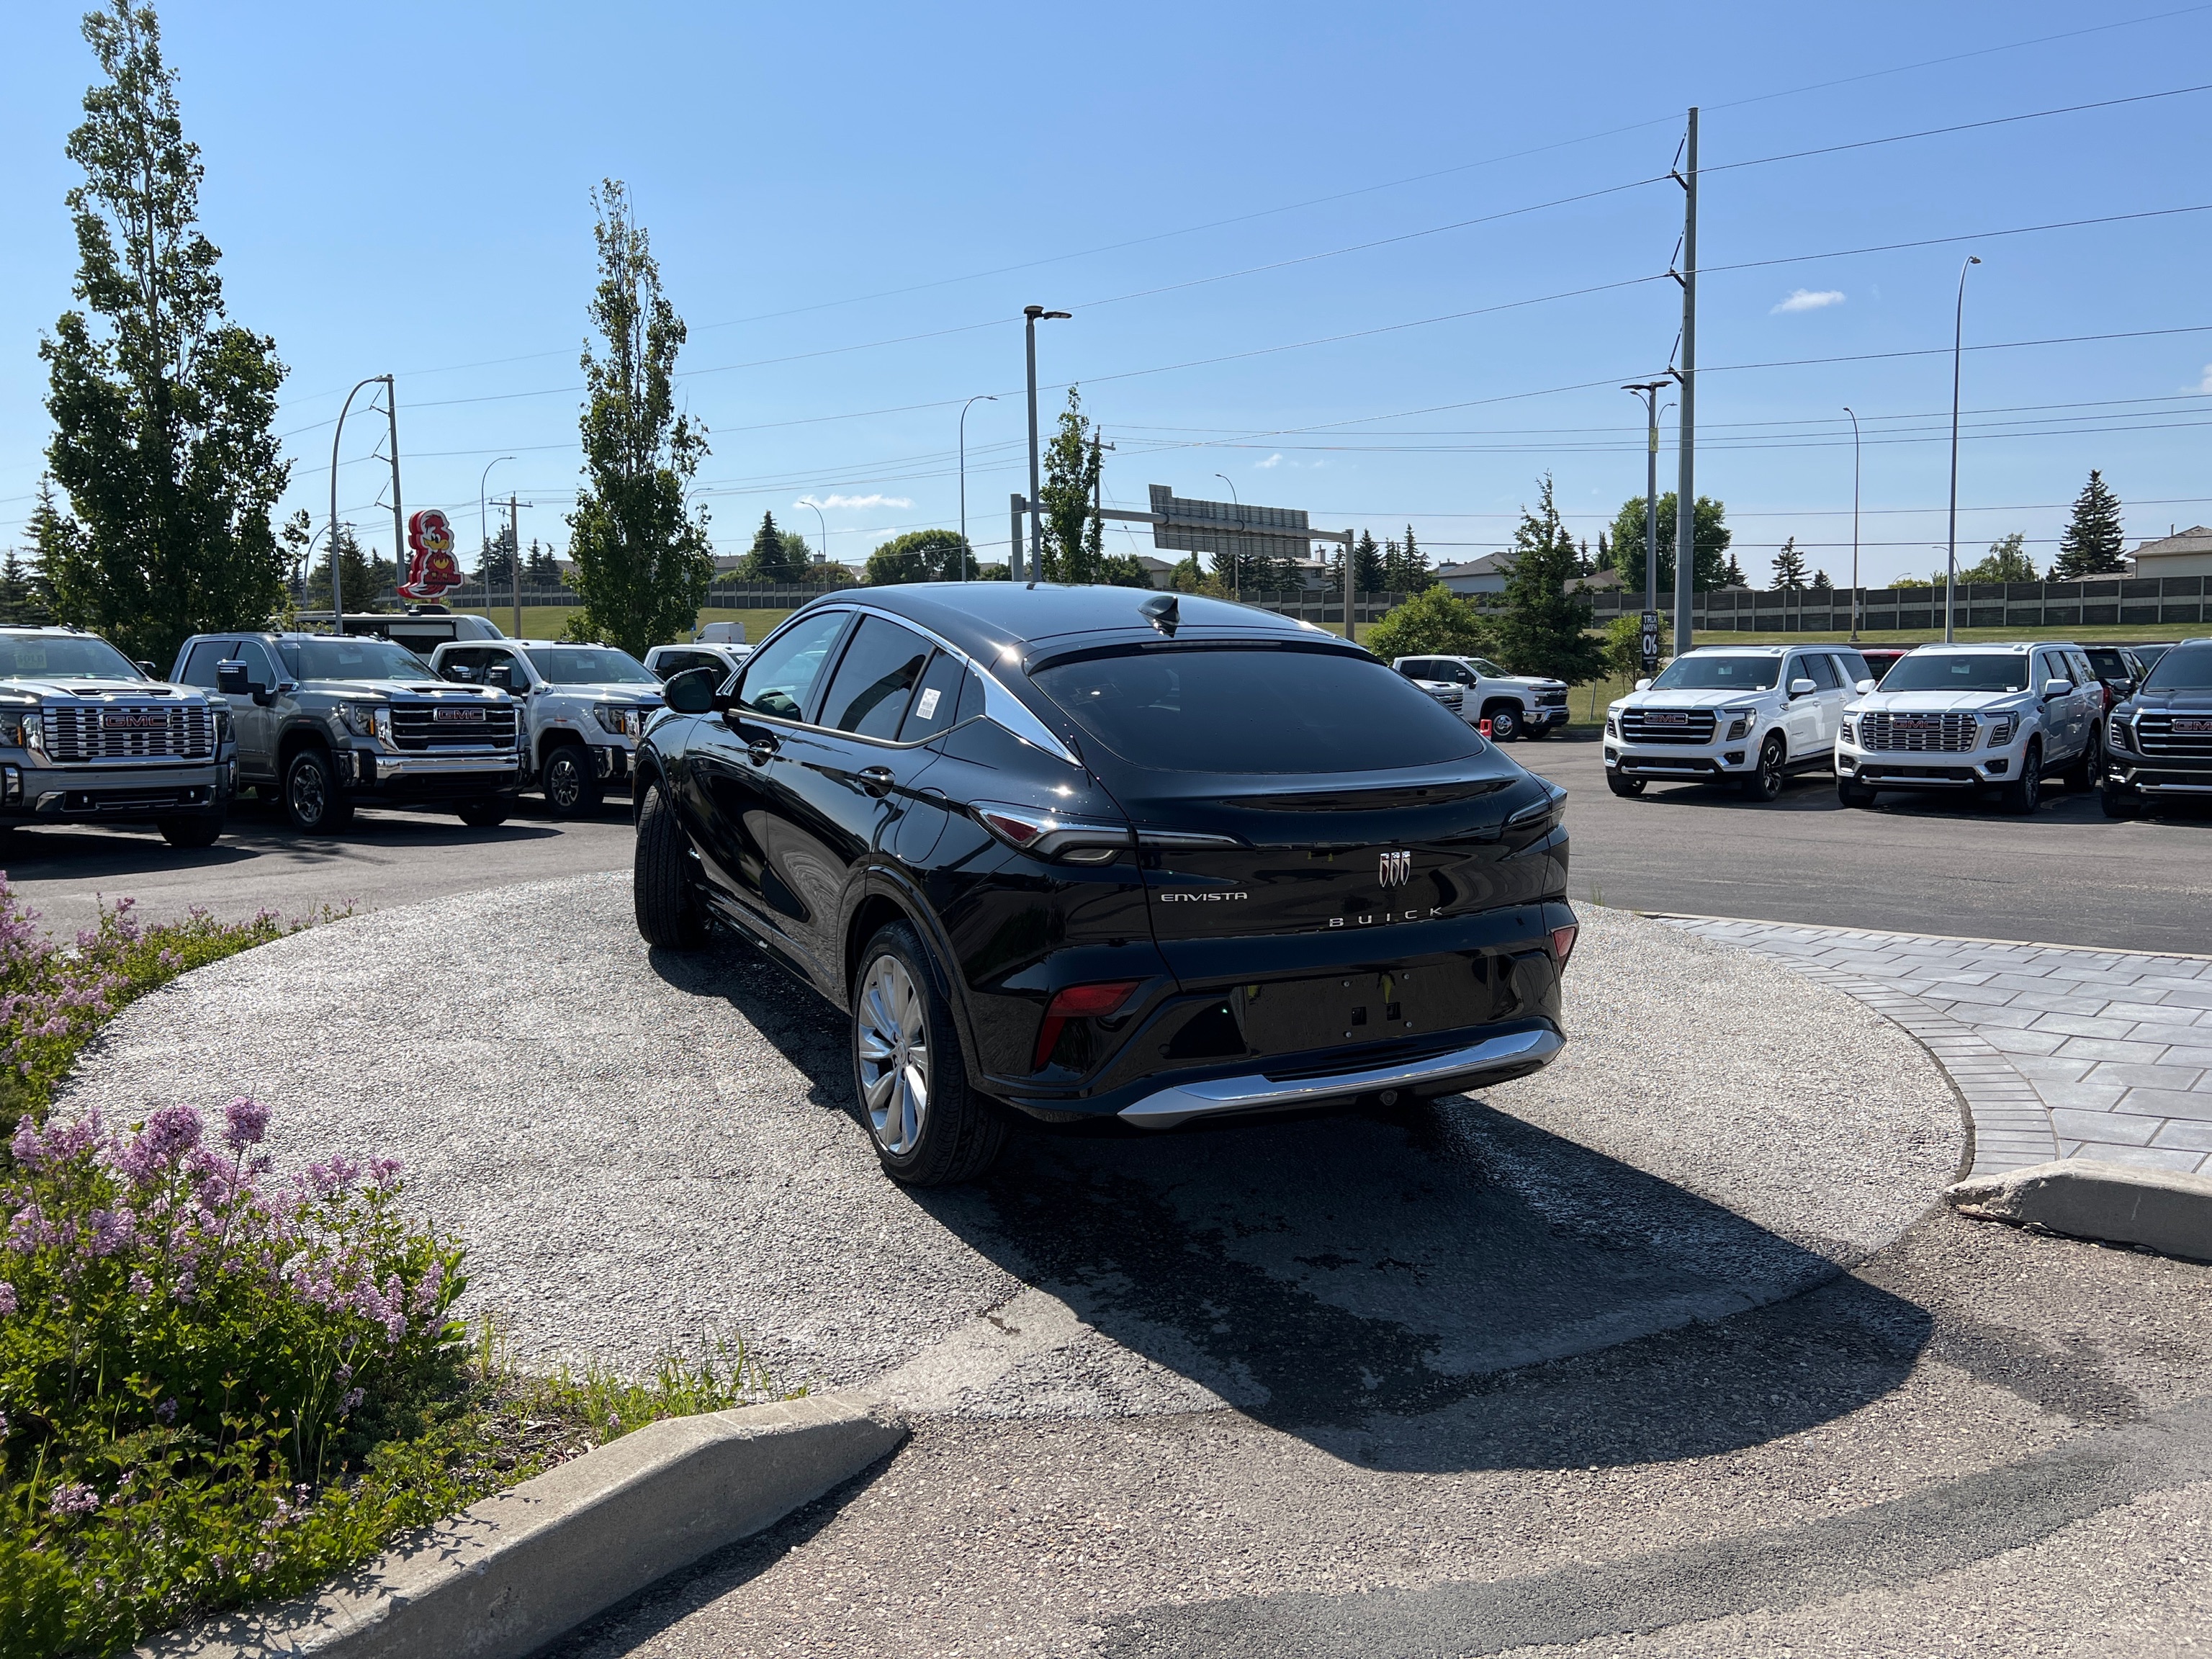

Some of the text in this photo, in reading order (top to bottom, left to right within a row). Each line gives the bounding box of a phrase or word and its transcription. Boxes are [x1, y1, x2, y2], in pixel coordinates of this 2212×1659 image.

[17, 654, 44, 663] SOLD
[439, 710, 483, 719] GMC
[106, 716, 166, 727] GMC
[1161, 892, 1248, 902] ENVISTA
[1329, 907, 1442, 927] BUICK
